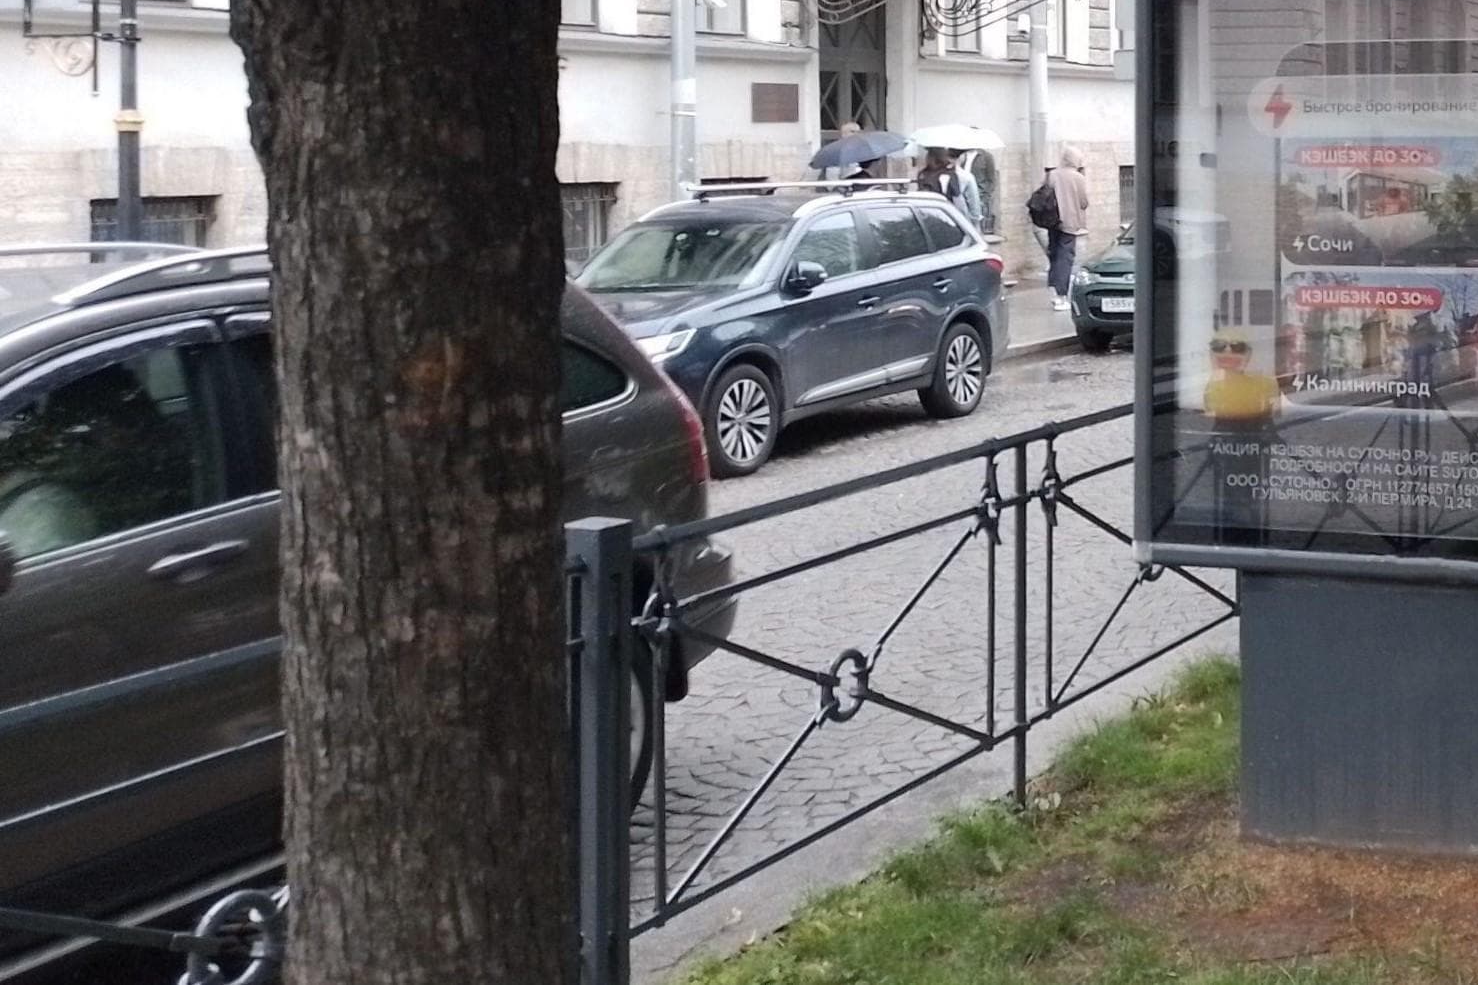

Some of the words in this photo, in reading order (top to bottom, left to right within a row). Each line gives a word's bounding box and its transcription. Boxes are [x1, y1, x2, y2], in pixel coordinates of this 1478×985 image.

[1303, 100, 1361, 115] Быстрое
[1366, 99, 1477, 115] бронирование
[1301, 151, 1369, 164] КЭШБЭК
[1373, 152, 1396, 165] ДО
[1400, 152, 1434, 164] 30%
[1307, 235, 1354, 252] Сочи
[1301, 289, 1371, 304] КЭШБЭК
[1375, 291, 1398, 305] ДО
[1401, 292, 1434, 306] 30%
[1307, 375, 1432, 397] Калининград
[1326, 446, 1344, 457] НА
[1269, 458, 1370, 474] ПОДРОБНОСТИ
[1373, 462, 1392, 475] НА
[1395, 463, 1438, 478] САЙТЕ
[1226, 474, 1258, 487] ООО
[1345, 478, 1382, 491] ОГРН
